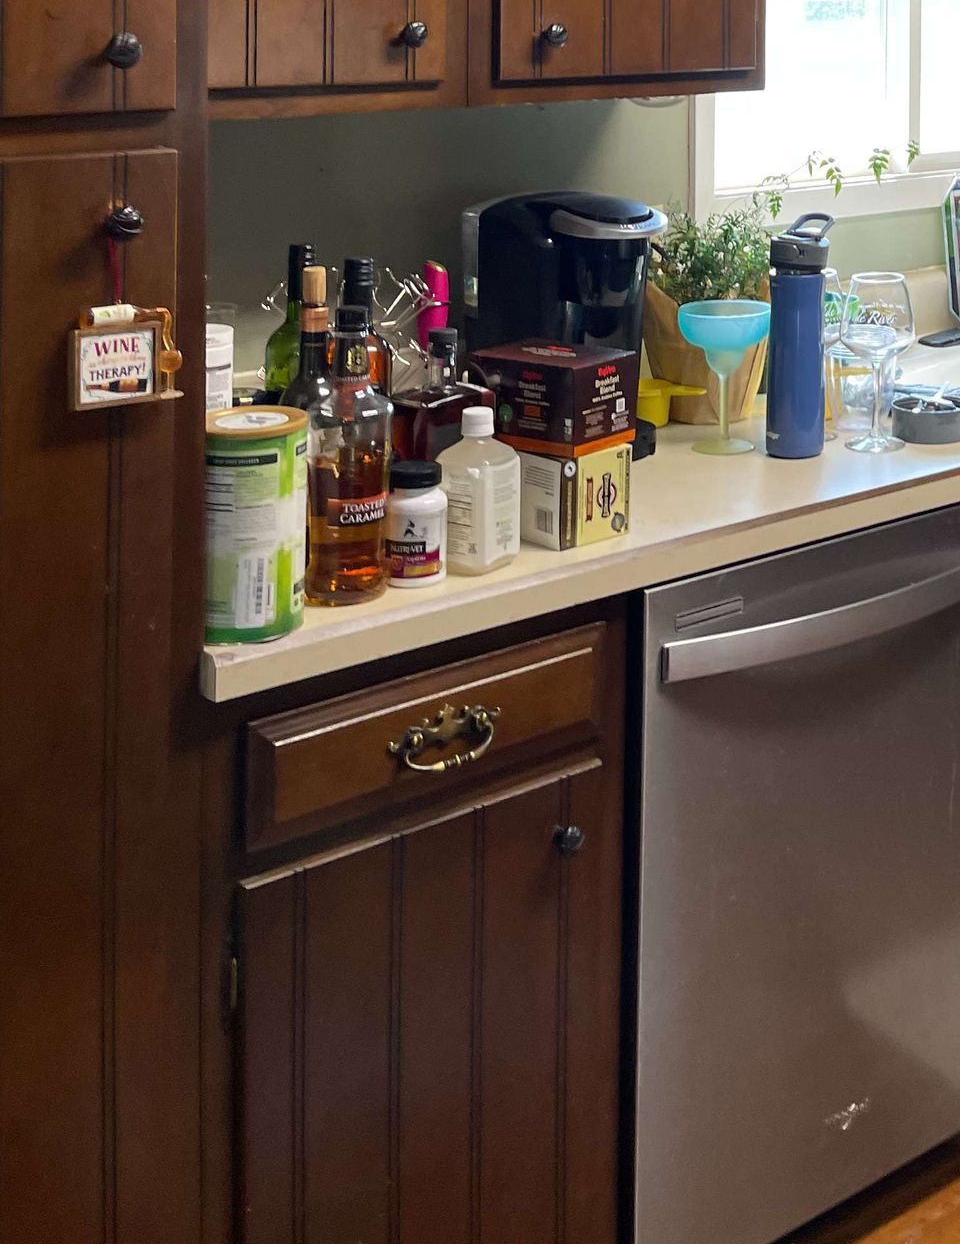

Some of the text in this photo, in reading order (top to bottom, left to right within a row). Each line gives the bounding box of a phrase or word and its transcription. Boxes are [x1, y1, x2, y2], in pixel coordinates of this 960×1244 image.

[94, 337, 140, 357] WINE
[89, 363, 146, 382] THERAPY!
[595, 375, 619, 388] Breakfast
[600, 384, 615, 394] Blend
[343, 499, 385, 513] TOASTED
[340, 510, 385, 525] CARAMEL
